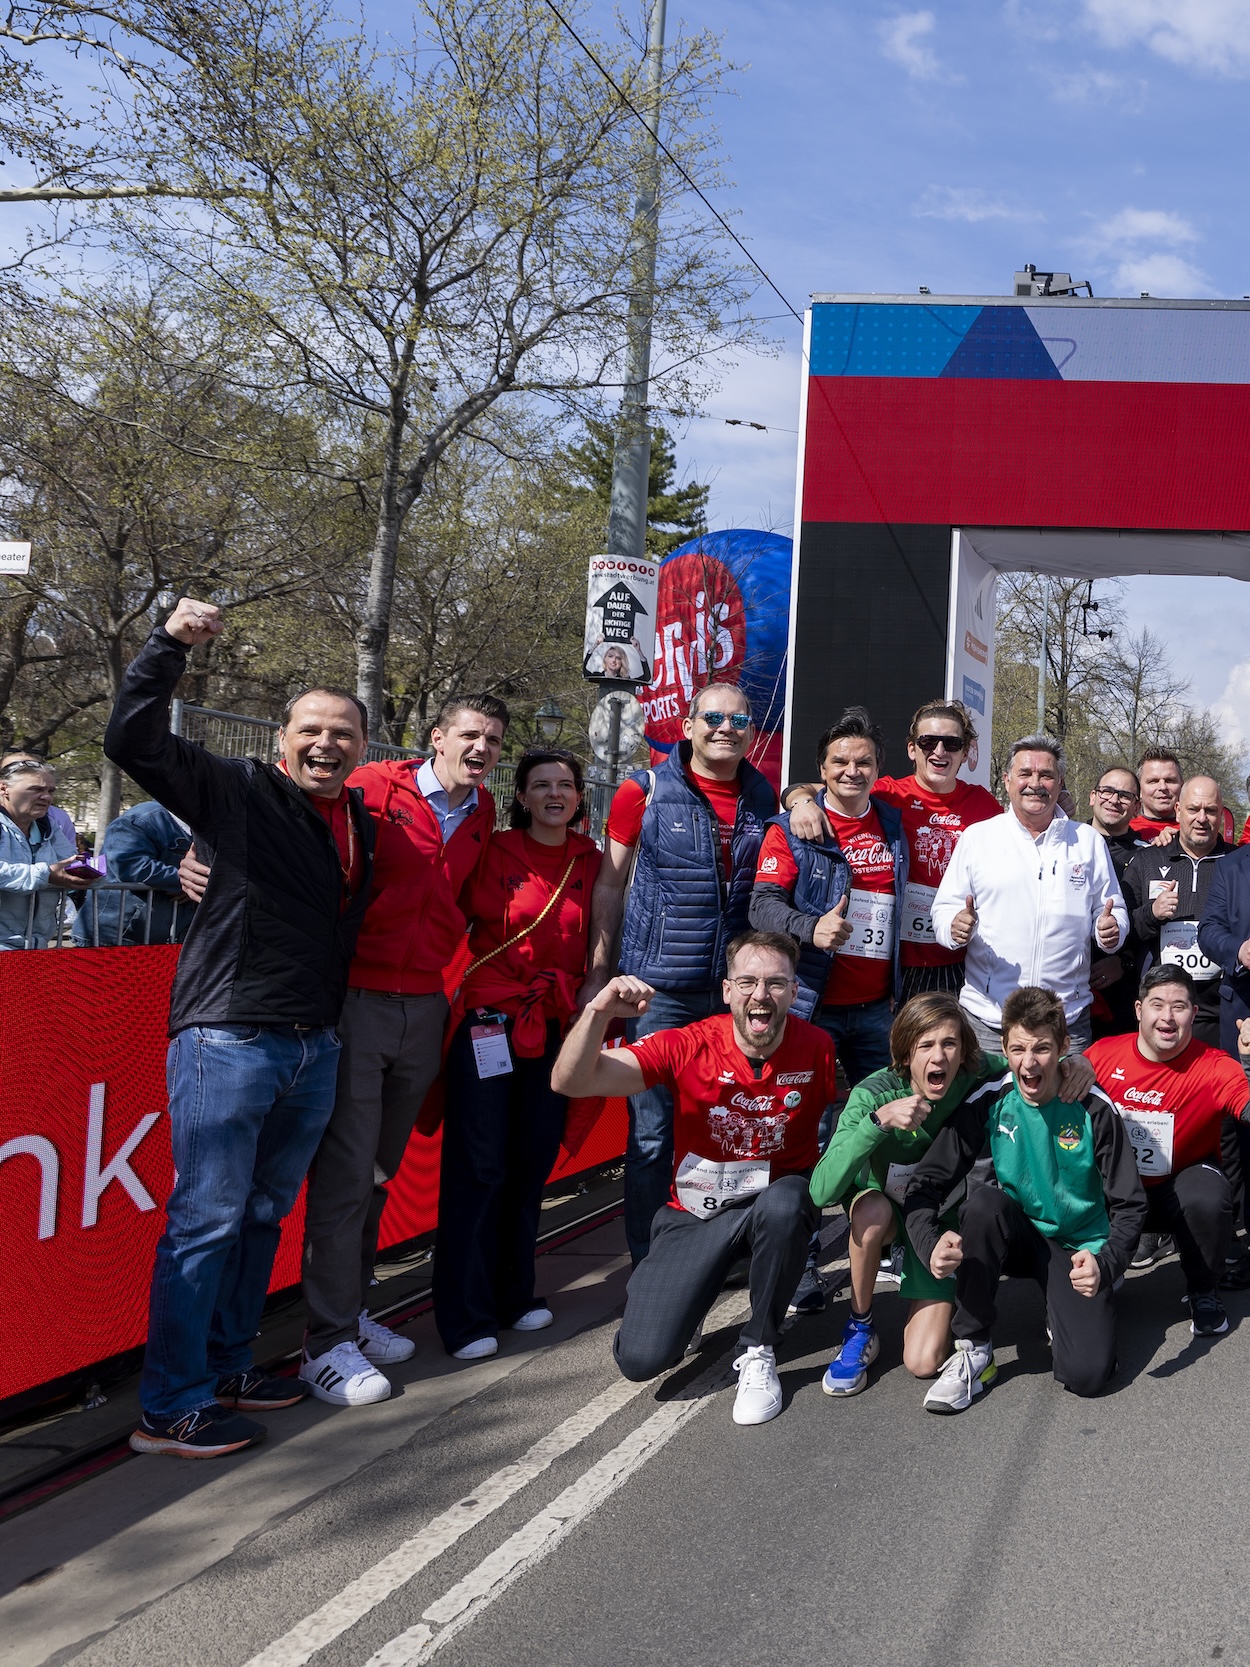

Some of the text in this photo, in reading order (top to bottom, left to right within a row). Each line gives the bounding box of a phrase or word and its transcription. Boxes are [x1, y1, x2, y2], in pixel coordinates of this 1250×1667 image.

[609, 591, 631, 602] AUF
[606, 601, 632, 611] DAUER
[604, 619, 632, 628] RICHTIGE
[605, 627, 629, 638] WEG
[640, 692, 681, 724] PORTS
[929, 812, 962, 826] Coca-Cola
[847, 832, 882, 845] MITEINAND
[843, 841, 894, 865] Coca-Cola
[852, 864, 892, 875] ÖSTERREICH
[912, 916, 935, 933] 62
[861, 927, 885, 946] 33
[1174, 954, 1212, 969] 300
[779, 1071, 812, 1085] Coca-Cola
[730, 1091, 776, 1112] Coca-Cola
[1123, 1086, 1166, 1106] Coca-Cola
[0, 1081, 179, 1241] nk
[684, 1162, 708, 1174] Laufend
[738, 1165, 765, 1174] erleben!
[685, 1179, 716, 1191] Coca-Cola
